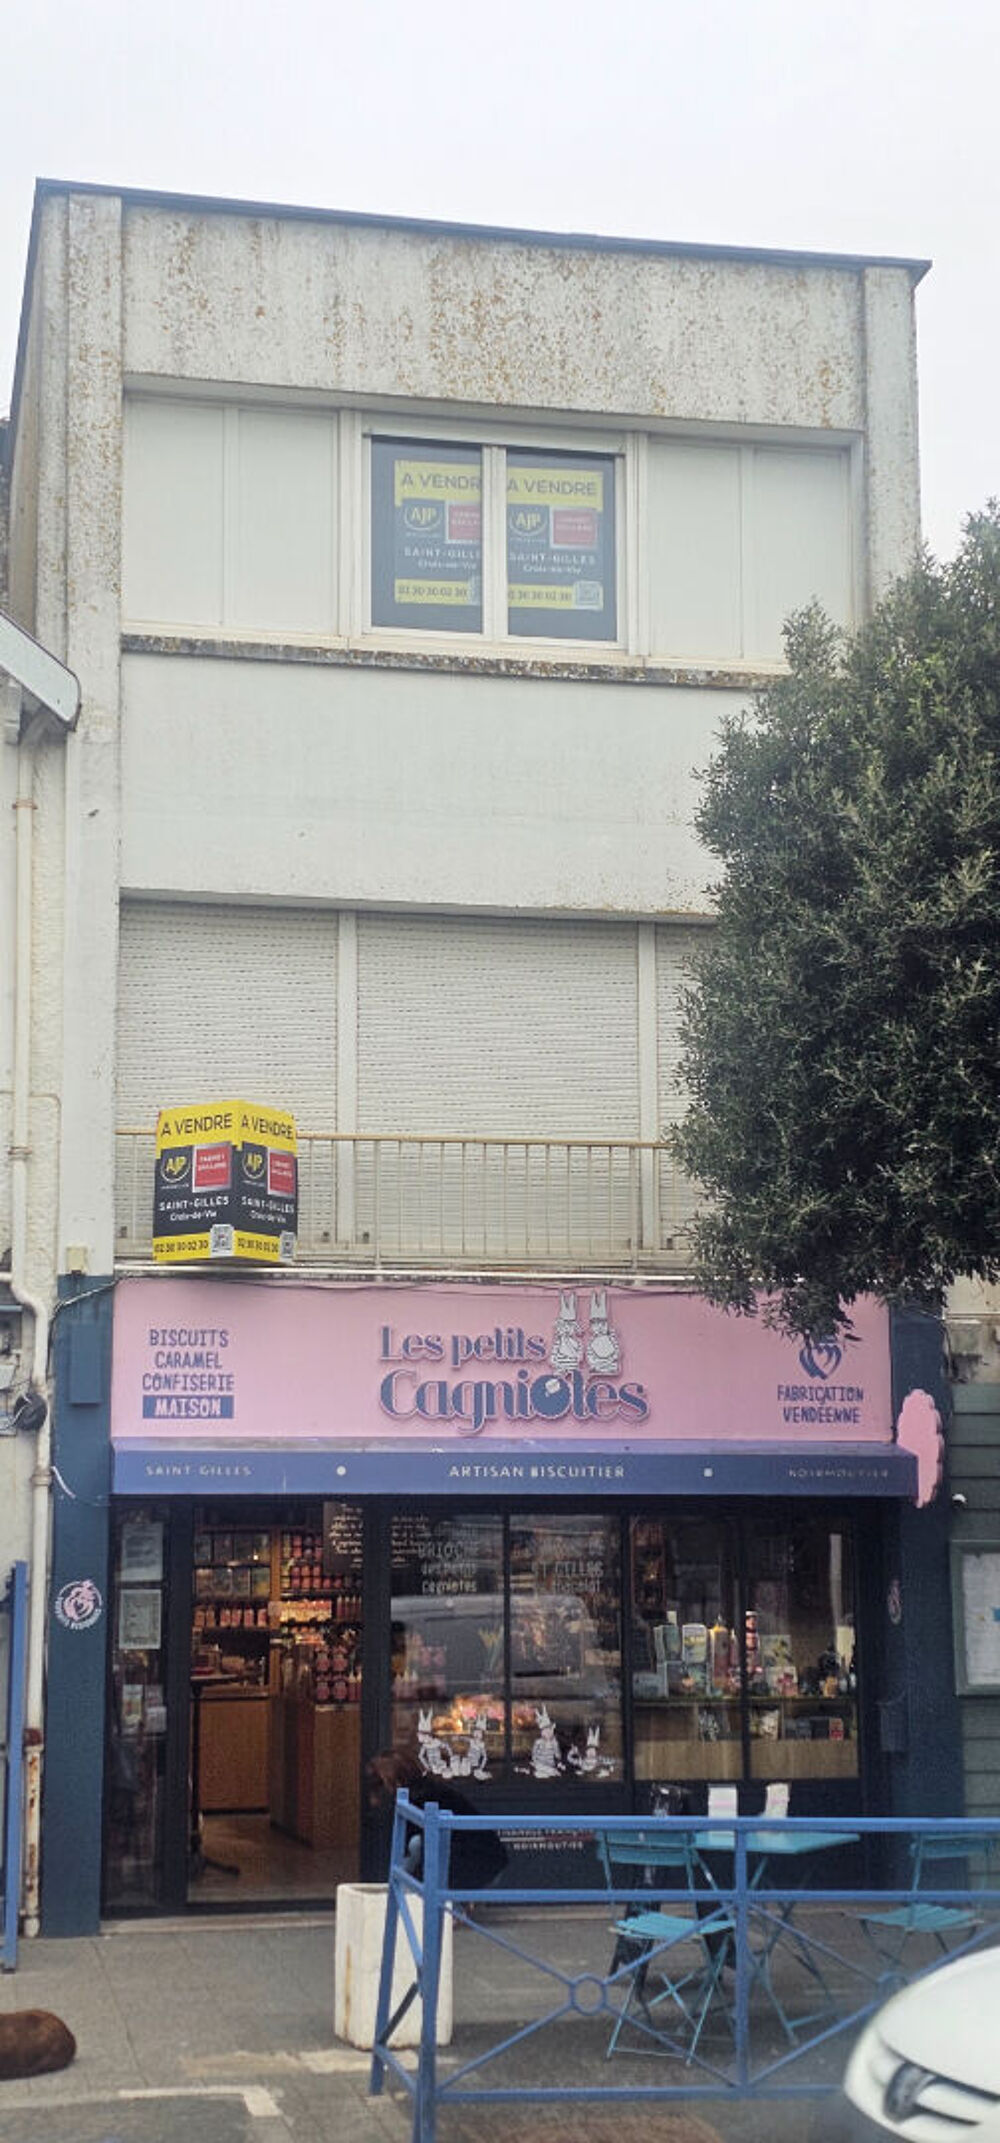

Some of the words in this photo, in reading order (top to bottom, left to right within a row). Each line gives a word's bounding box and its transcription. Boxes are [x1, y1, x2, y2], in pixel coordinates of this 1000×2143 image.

[401, 473, 414, 487] A
[420, 474, 481, 491] VENDR
[507, 479, 518, 492] A
[524, 479, 596, 496] VENDRE
[411, 506, 437, 525] AJP
[516, 512, 542, 531] AJP
[404, 546, 481, 560] SAINT-GILLE
[160, 1121, 171, 1137] A
[174, 1112, 233, 1135] VENDRE
[241, 1114, 249, 1129] A
[252, 1116, 294, 1140] VENDRE
[159, 1195, 230, 1212] SAINT-GILLES
[149, 1328, 230, 1348] BISCUITS
[378, 1325, 445, 1362] Les
[450, 1326, 548, 1370] petits
[154, 1350, 223, 1369] CARAMEL
[141, 1373, 235, 1393] CONFISERIE
[777, 1384, 864, 1401] FABRICATION
[154, 1395, 222, 1416] MAISON
[145, 1465, 191, 1476] SAINT
[200, 1465, 253, 1476] GILLES
[449, 1464, 525, 1478] ARTISAN
[529, 1465, 625, 1478] BISCUITIER
